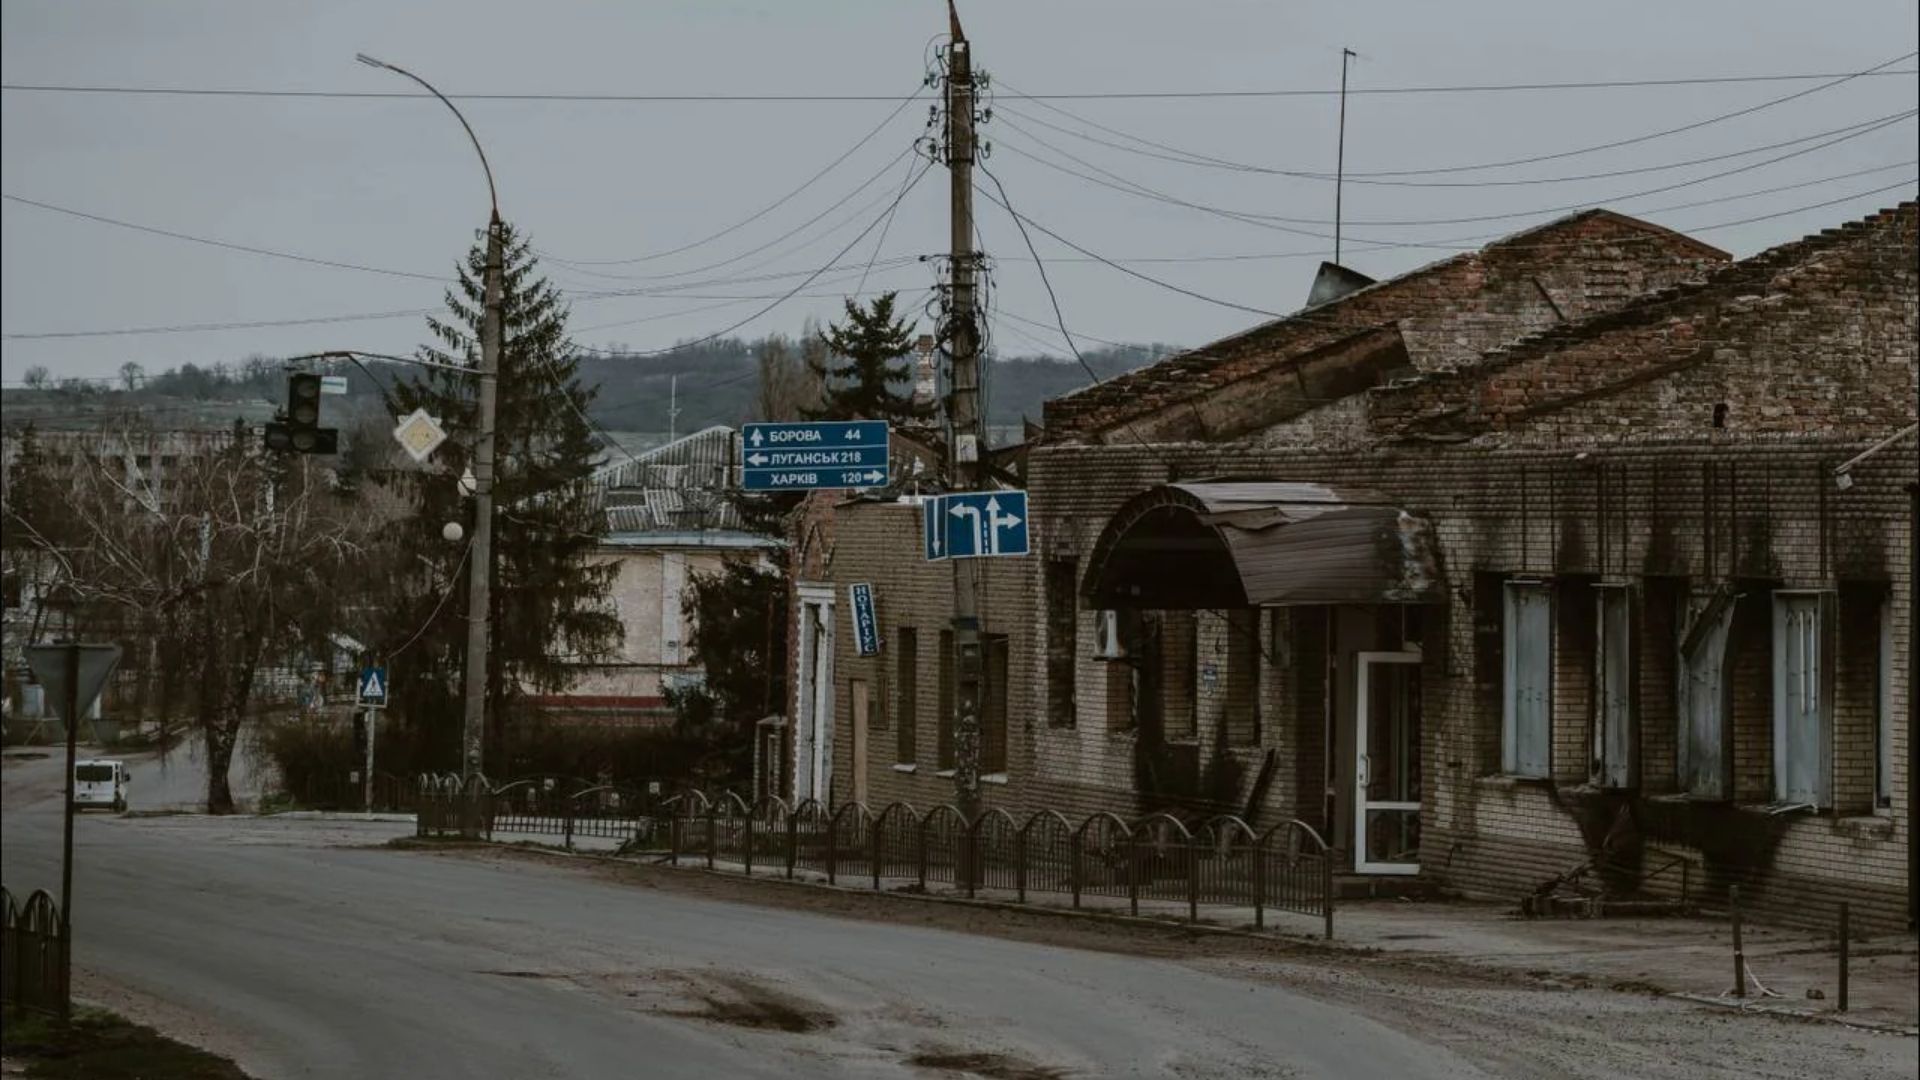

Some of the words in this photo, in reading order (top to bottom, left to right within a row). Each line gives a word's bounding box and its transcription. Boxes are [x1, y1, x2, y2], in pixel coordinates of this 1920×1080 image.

[769, 430, 822, 442] БОРОВА
[844, 429, 861, 440] 44
[770, 452, 839, 465] ЛУГАНСЬК
[840, 451, 862, 463] 218
[770, 473, 818, 485] ХАРКІВ
[841, 472, 862, 483] 120
[855, 586, 875, 652] НОТАРІУС
